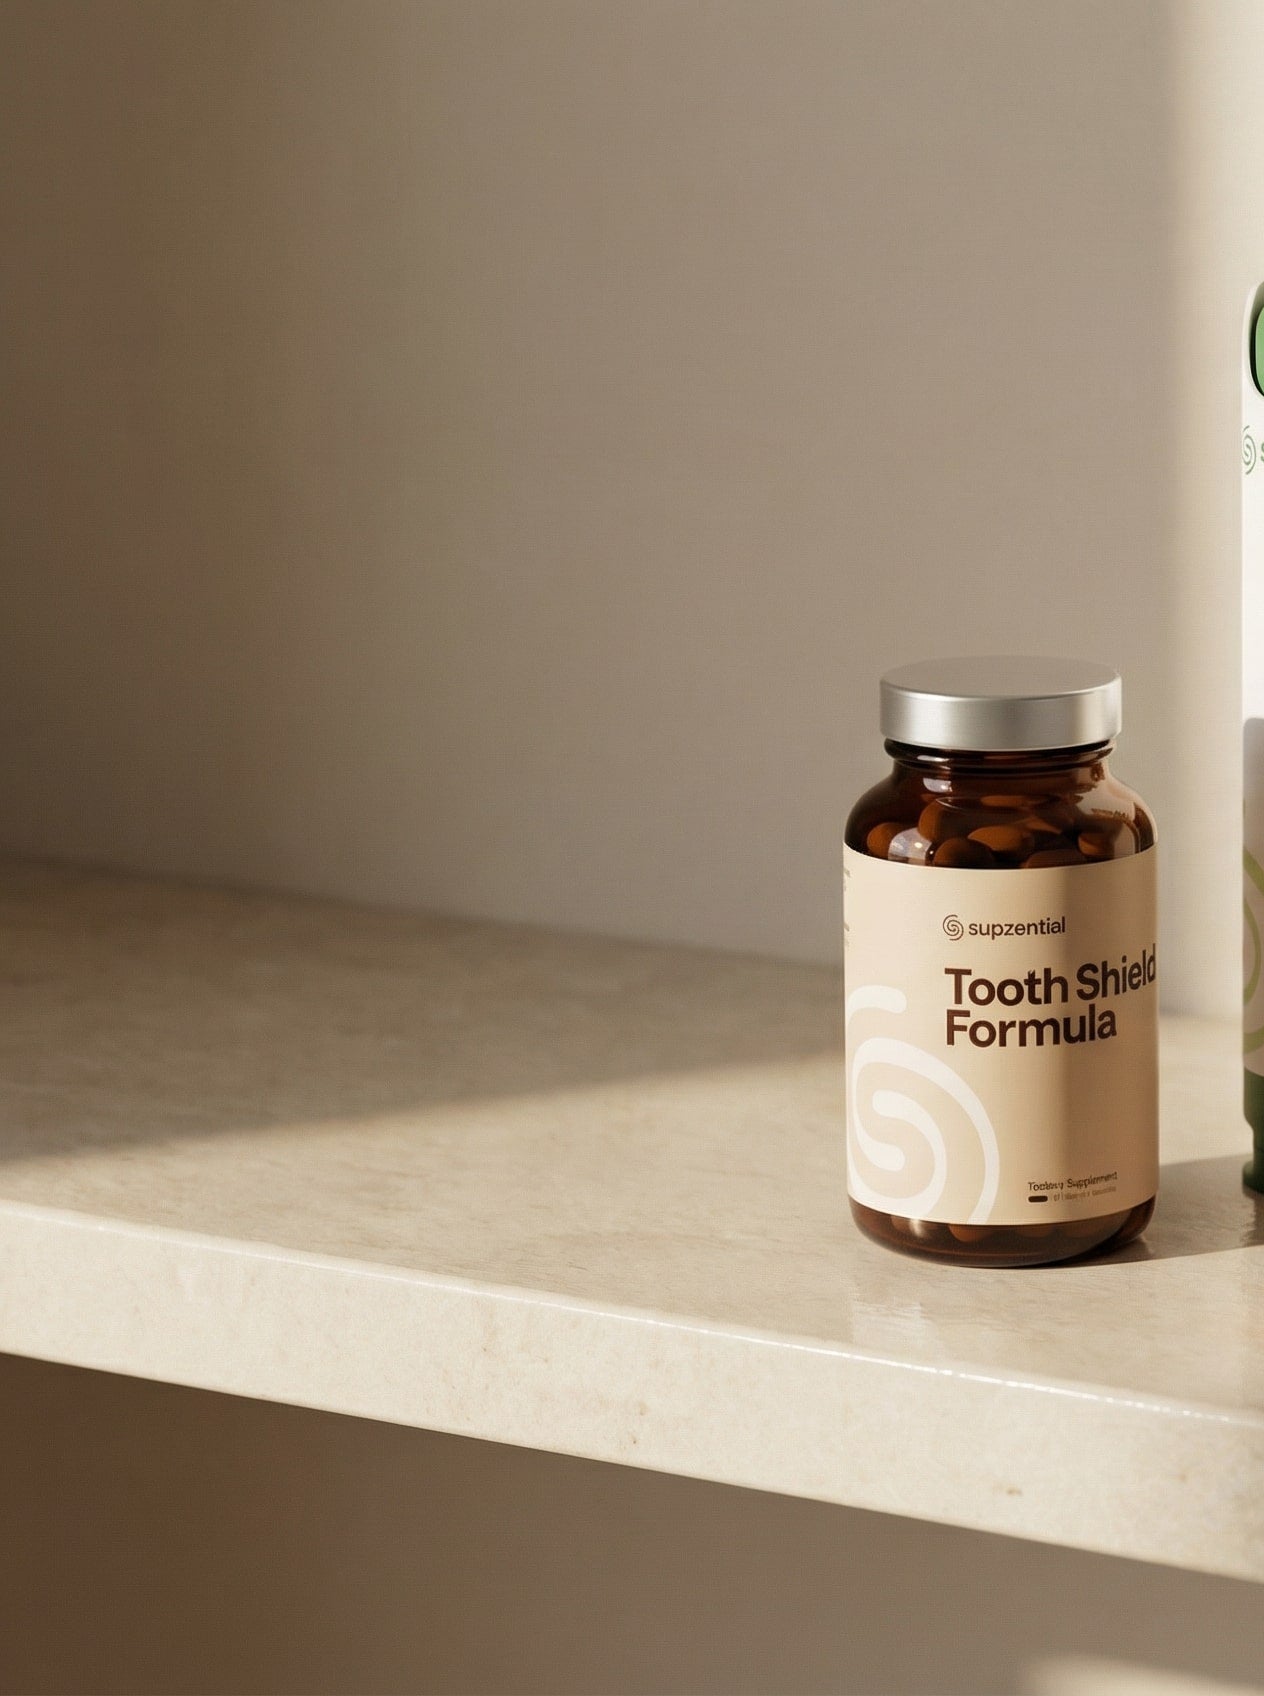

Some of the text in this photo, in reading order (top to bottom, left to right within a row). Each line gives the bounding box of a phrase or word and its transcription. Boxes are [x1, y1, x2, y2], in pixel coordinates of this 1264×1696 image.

[968, 916, 1066, 940] supzential
[944, 943, 1156, 1007] Tooth Shield
[946, 1003, 1117, 1048] Formula
